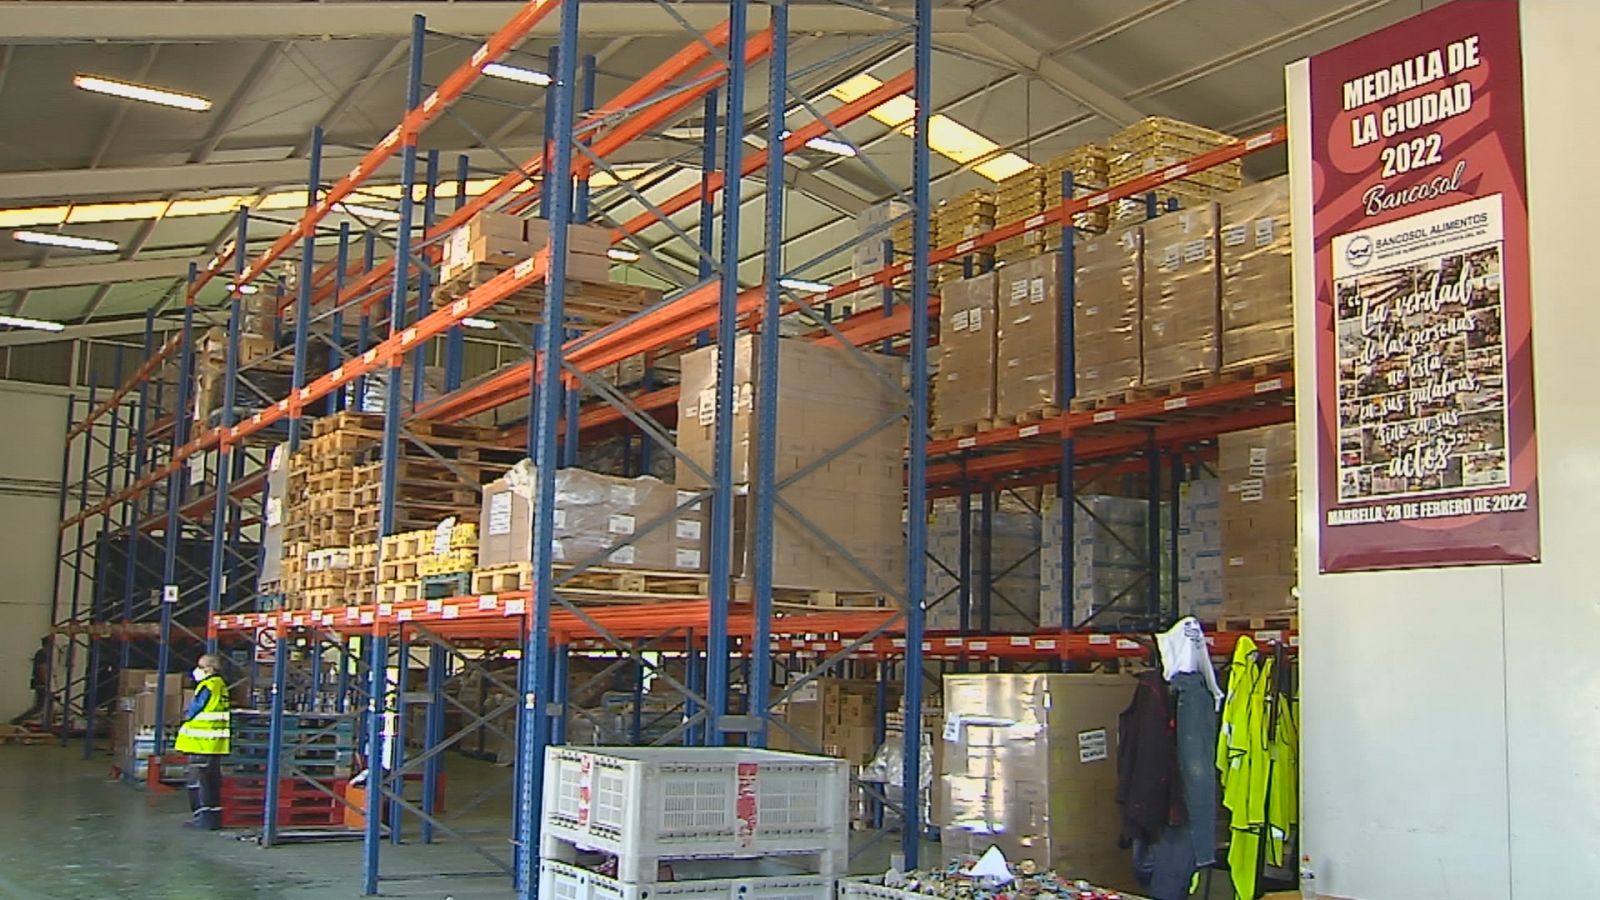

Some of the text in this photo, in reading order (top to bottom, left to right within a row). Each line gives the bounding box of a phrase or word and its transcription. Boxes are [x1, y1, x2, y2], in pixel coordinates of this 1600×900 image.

[1343, 36, 1480, 110] MEDALLA DE
[1351, 82, 1472, 147] LA CIUDAD
[1381, 133, 1443, 178] 2022
[1362, 160, 1466, 216] Bancosol
[1376, 229, 1428, 249] BANCOSOL
[1430, 213, 1488, 235] ALIMENTOS
[1396, 262, 1472, 317] verdad
[1360, 315, 1477, 365] de las personas
[1376, 394, 1406, 416] sus
[1386, 504, 1401, 521] 28
[1402, 502, 1419, 519] DE
[1420, 498, 1472, 517] FEBRERO
[1474, 496, 1491, 513] DE
[1492, 493, 1527, 512] 2022
